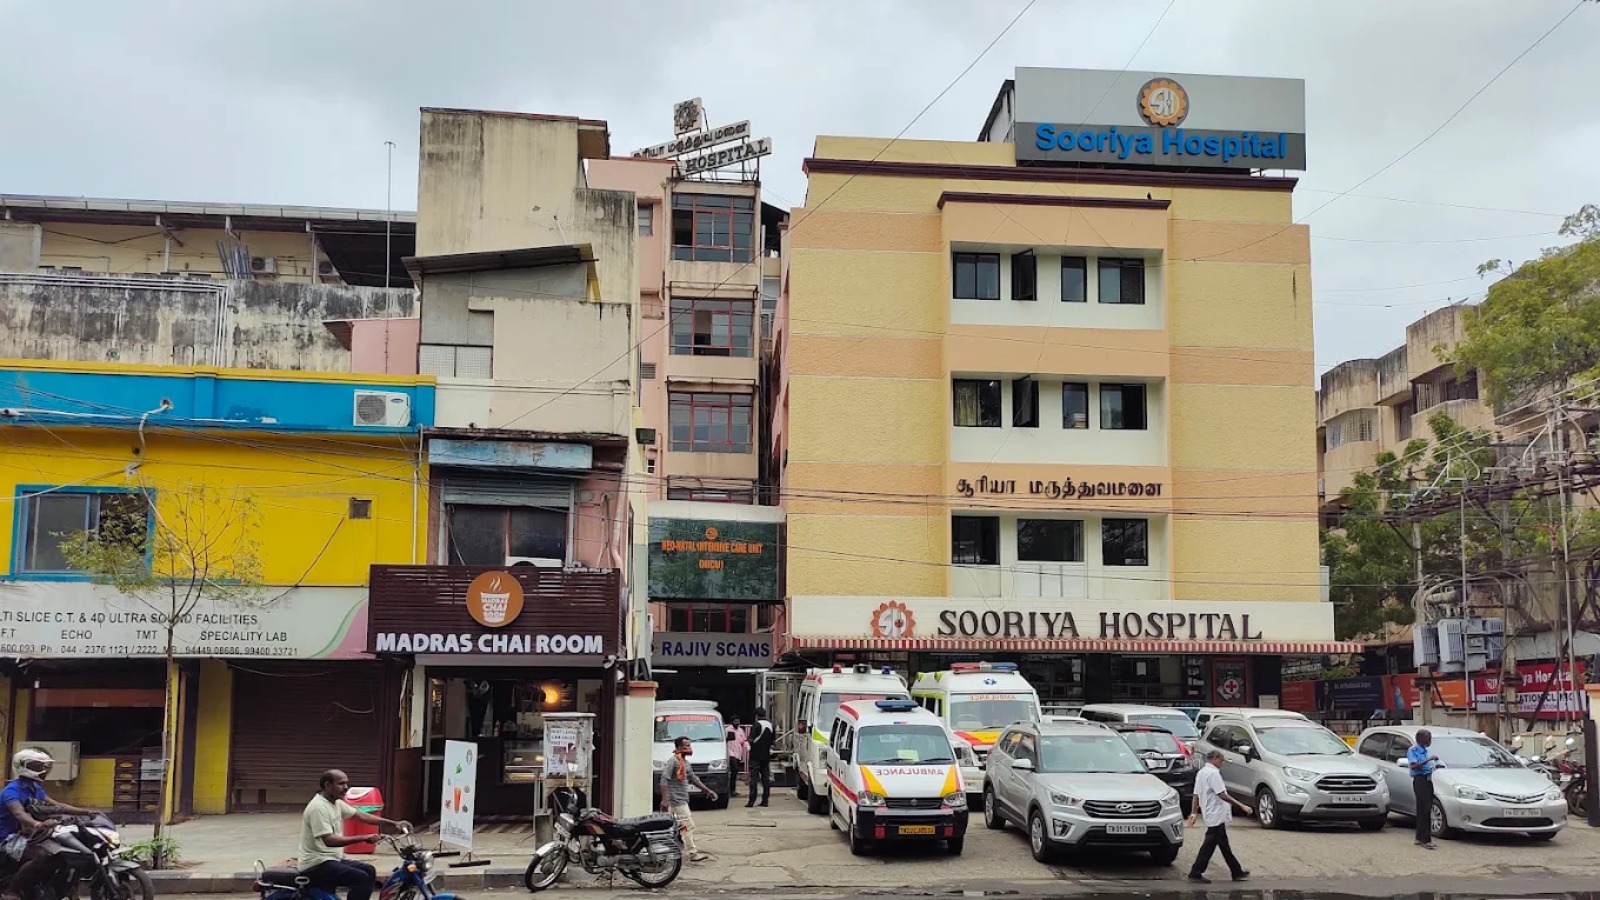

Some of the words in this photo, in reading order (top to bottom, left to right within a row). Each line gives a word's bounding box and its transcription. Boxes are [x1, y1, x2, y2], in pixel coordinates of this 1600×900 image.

[1035, 124, 1153, 160] Sooriya
[1162, 128, 1287, 163] Hospital
[685, 139, 768, 173] HOSPITAL
[956, 475, 1016, 498] சூரியா
[1029, 477, 1163, 499] மருத்துவமனை
[0, 611, 12, 621] TI
[16, 611, 51, 622] SLICE
[54, 612, 75, 623] C.T.
[79, 612, 87, 623] &
[90, 612, 106, 623] 4D
[108, 612, 148, 623] ULTRA
[196, 613, 258, 625] FACILITIES
[938, 610, 1079, 638] SOORIYA
[1099, 612, 1262, 640] HOSPITAL
[61, 629, 93, 640] ECHO
[136, 629, 158, 640] TMT
[200, 631, 263, 641] SPECIALITY
[266, 632, 288, 642] LAB
[376, 633, 473, 653] MADRAS
[478, 634, 531, 653] CHAI
[536, 634, 603, 654] ROOM
[661, 641, 711, 656] RAJIV
[716, 641, 770, 657] SCANS
